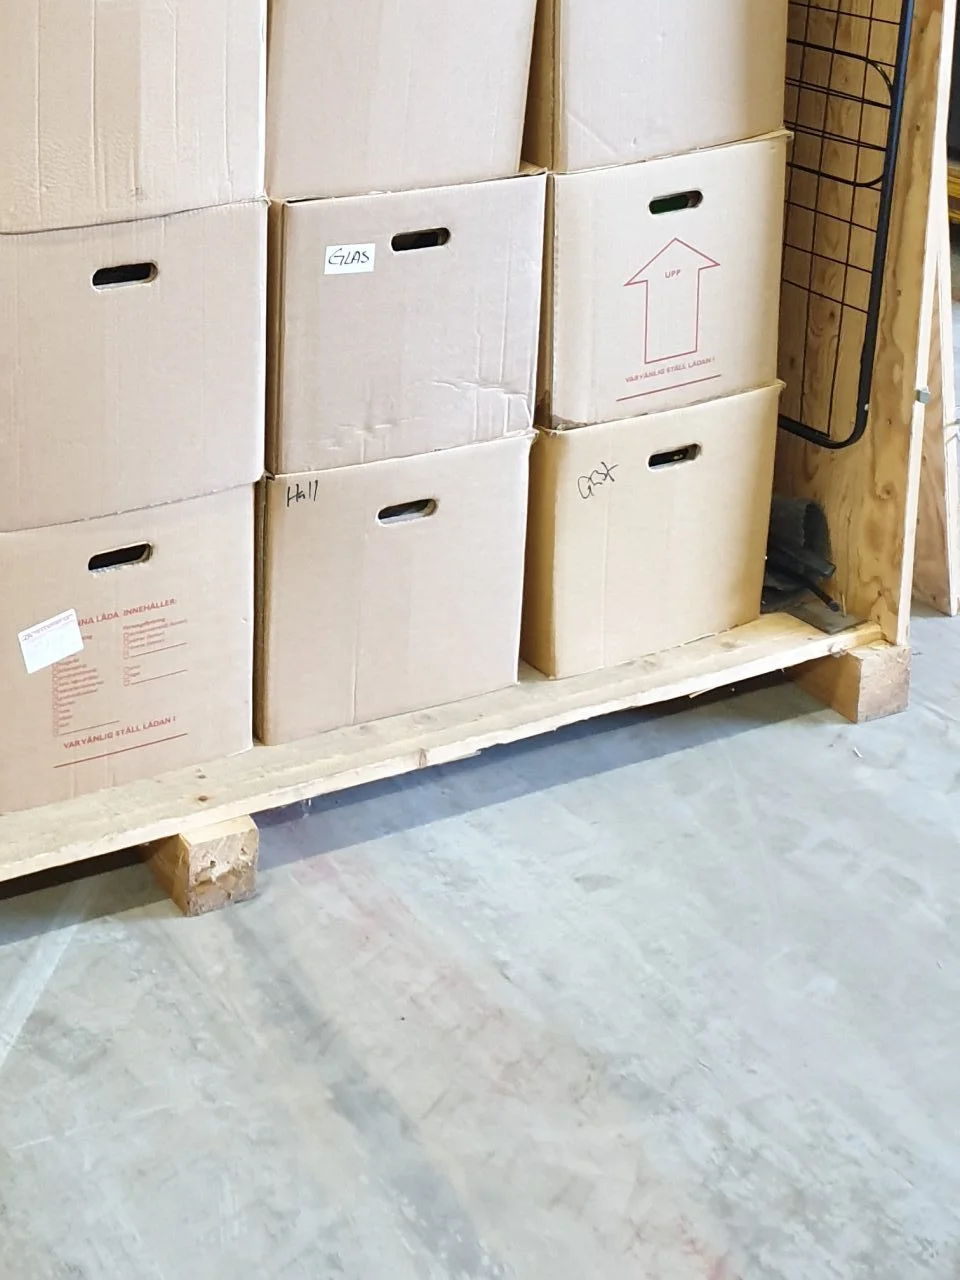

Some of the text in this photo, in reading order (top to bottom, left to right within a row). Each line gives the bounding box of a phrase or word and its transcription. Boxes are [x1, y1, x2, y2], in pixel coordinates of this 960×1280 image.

[328, 247, 370, 266] GLAS
[664, 269, 681, 279] UPP
[286, 479, 319, 508] Hall
[96, 610, 120, 623] LÅDA
[122, 598, 177, 617] INNEHÅLLER:
[63, 738, 81, 750] VAR
[80, 730, 114, 746] VÄNLIG
[115, 724, 141, 738] STÄLL
[142, 717, 171, 732] LÅDAN
